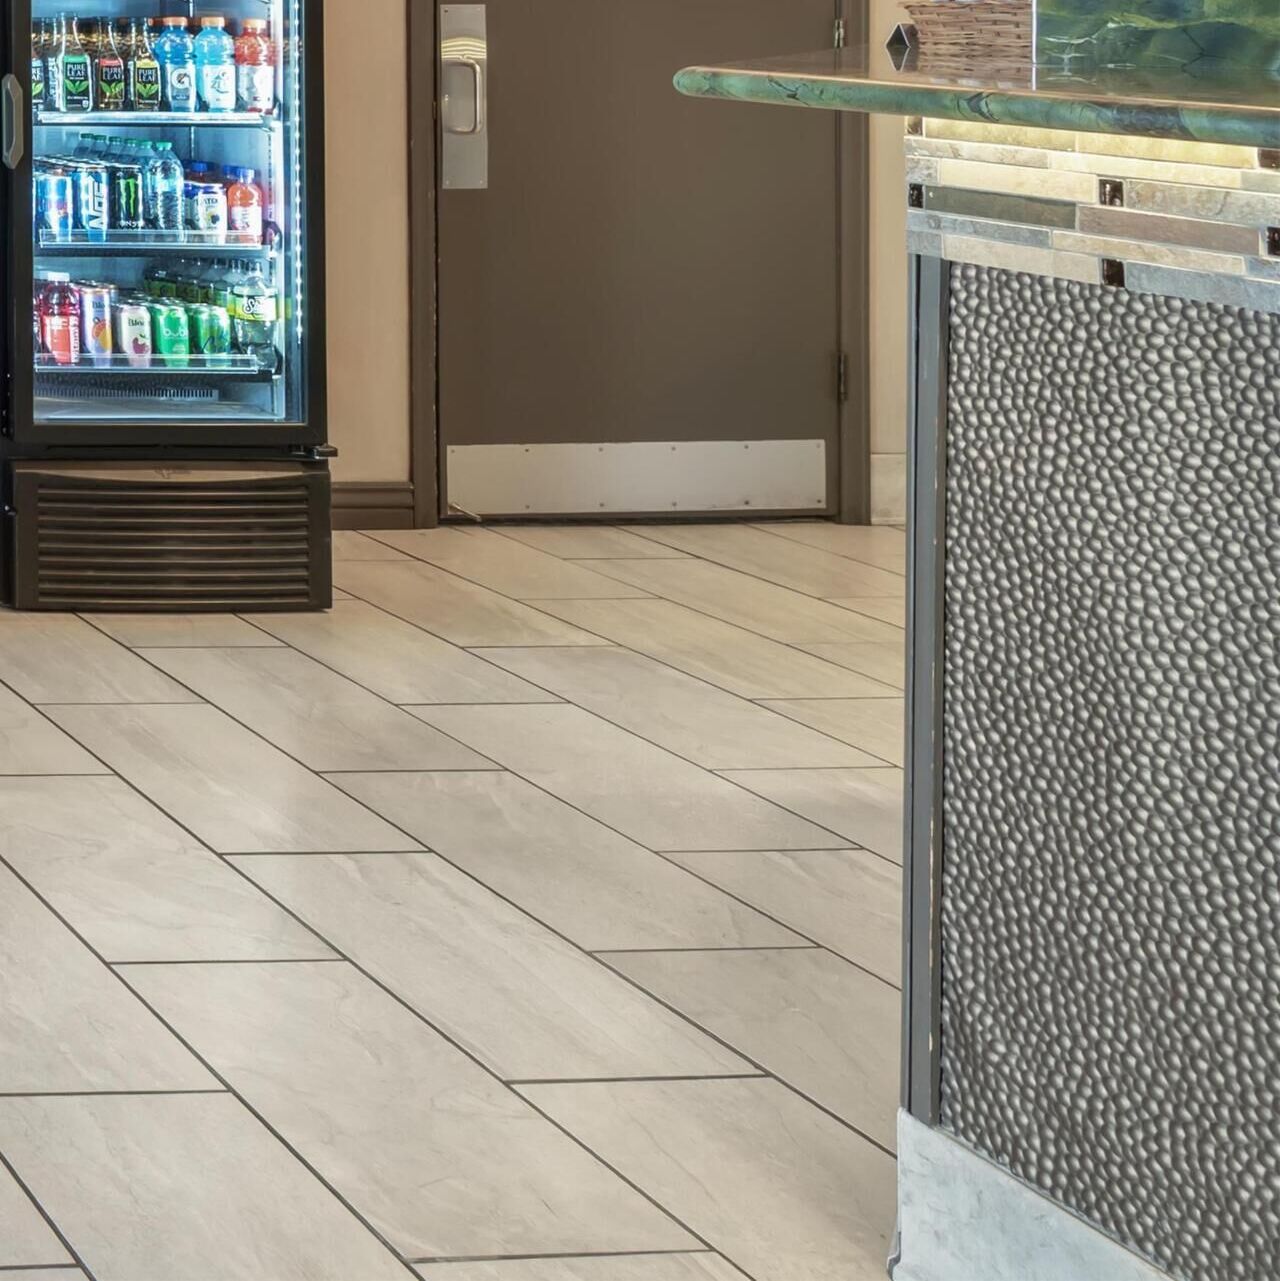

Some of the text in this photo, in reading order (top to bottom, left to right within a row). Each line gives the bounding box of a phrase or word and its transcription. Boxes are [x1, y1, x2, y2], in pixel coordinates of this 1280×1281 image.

[67, 63, 86, 71] PURE
[102, 66, 122, 74] PURE
[67, 69, 86, 77] LEAF
